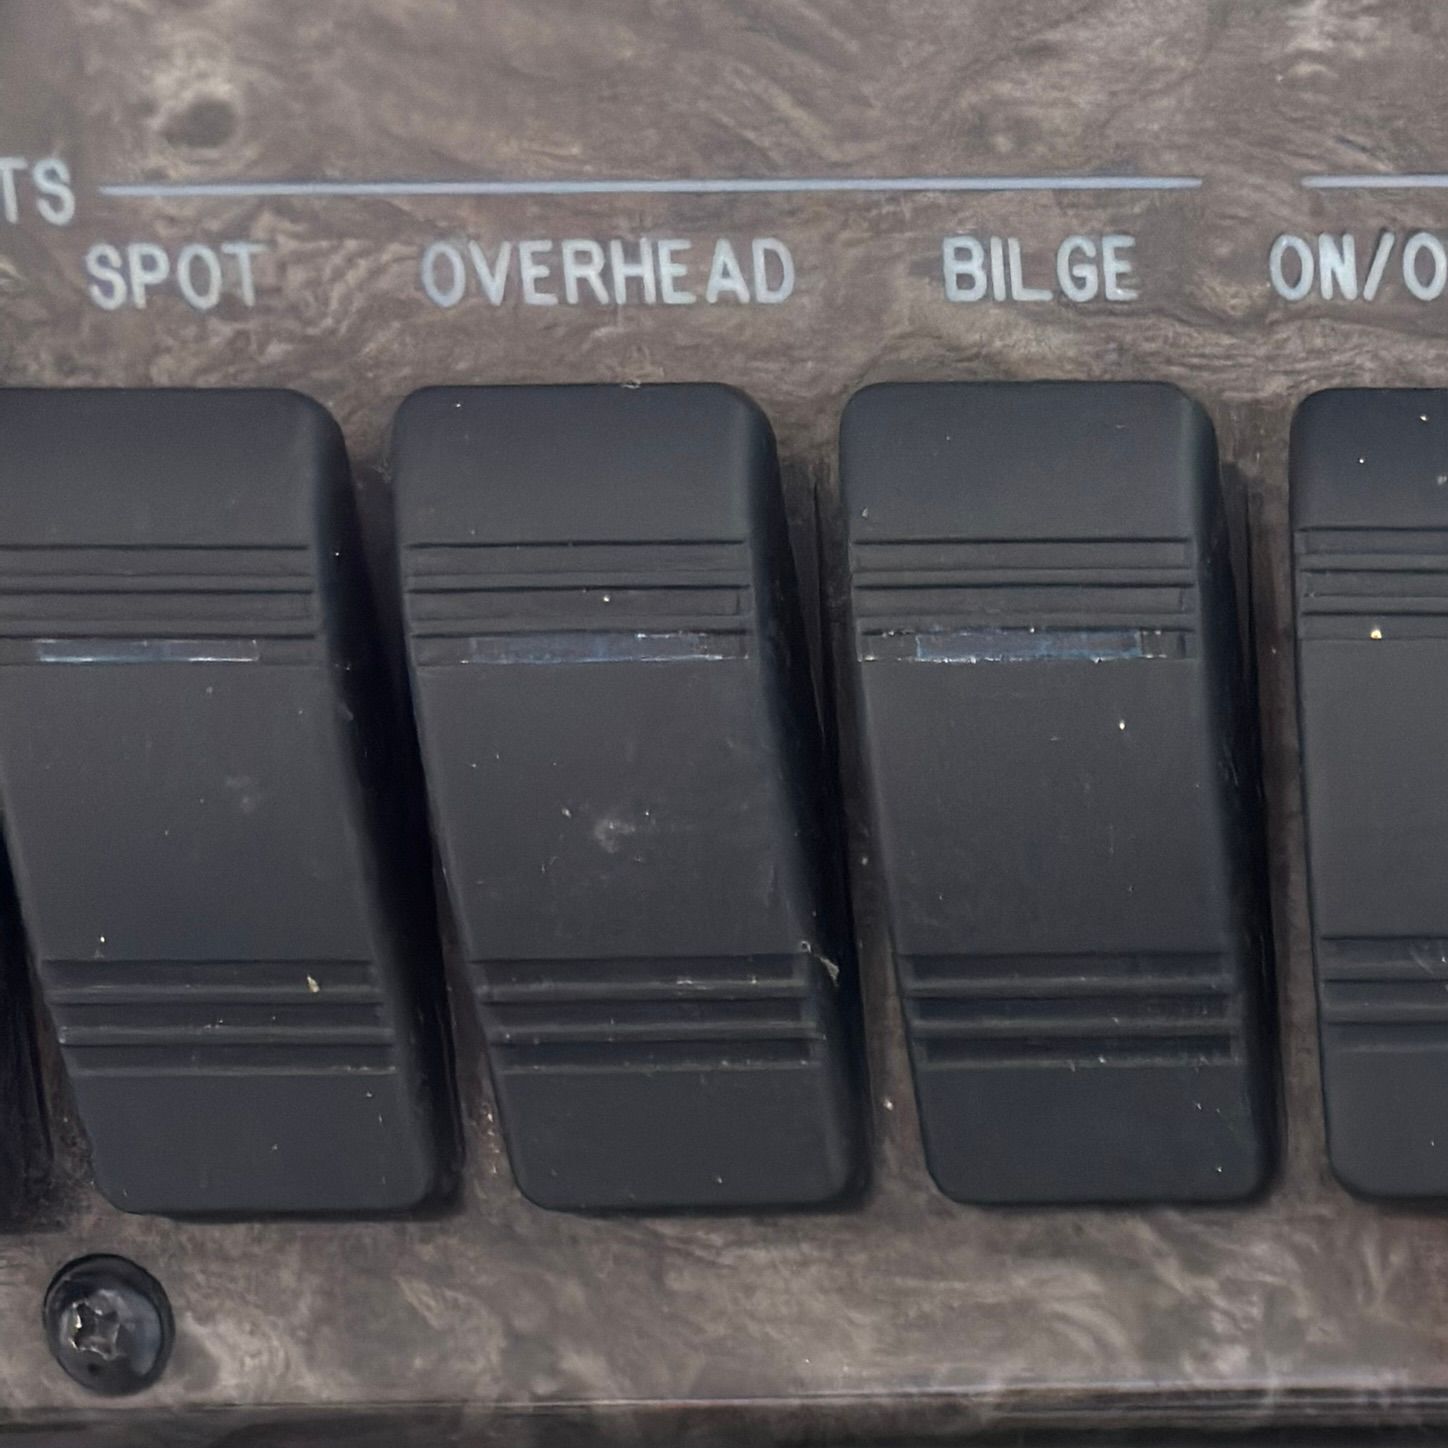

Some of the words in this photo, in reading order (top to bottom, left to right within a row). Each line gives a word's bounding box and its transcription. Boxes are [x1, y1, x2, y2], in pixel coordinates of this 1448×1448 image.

[84, 242, 268, 310] SPOT
[420, 236, 796, 307] OVERHEAD
[942, 236, 1138, 306] BILGE
